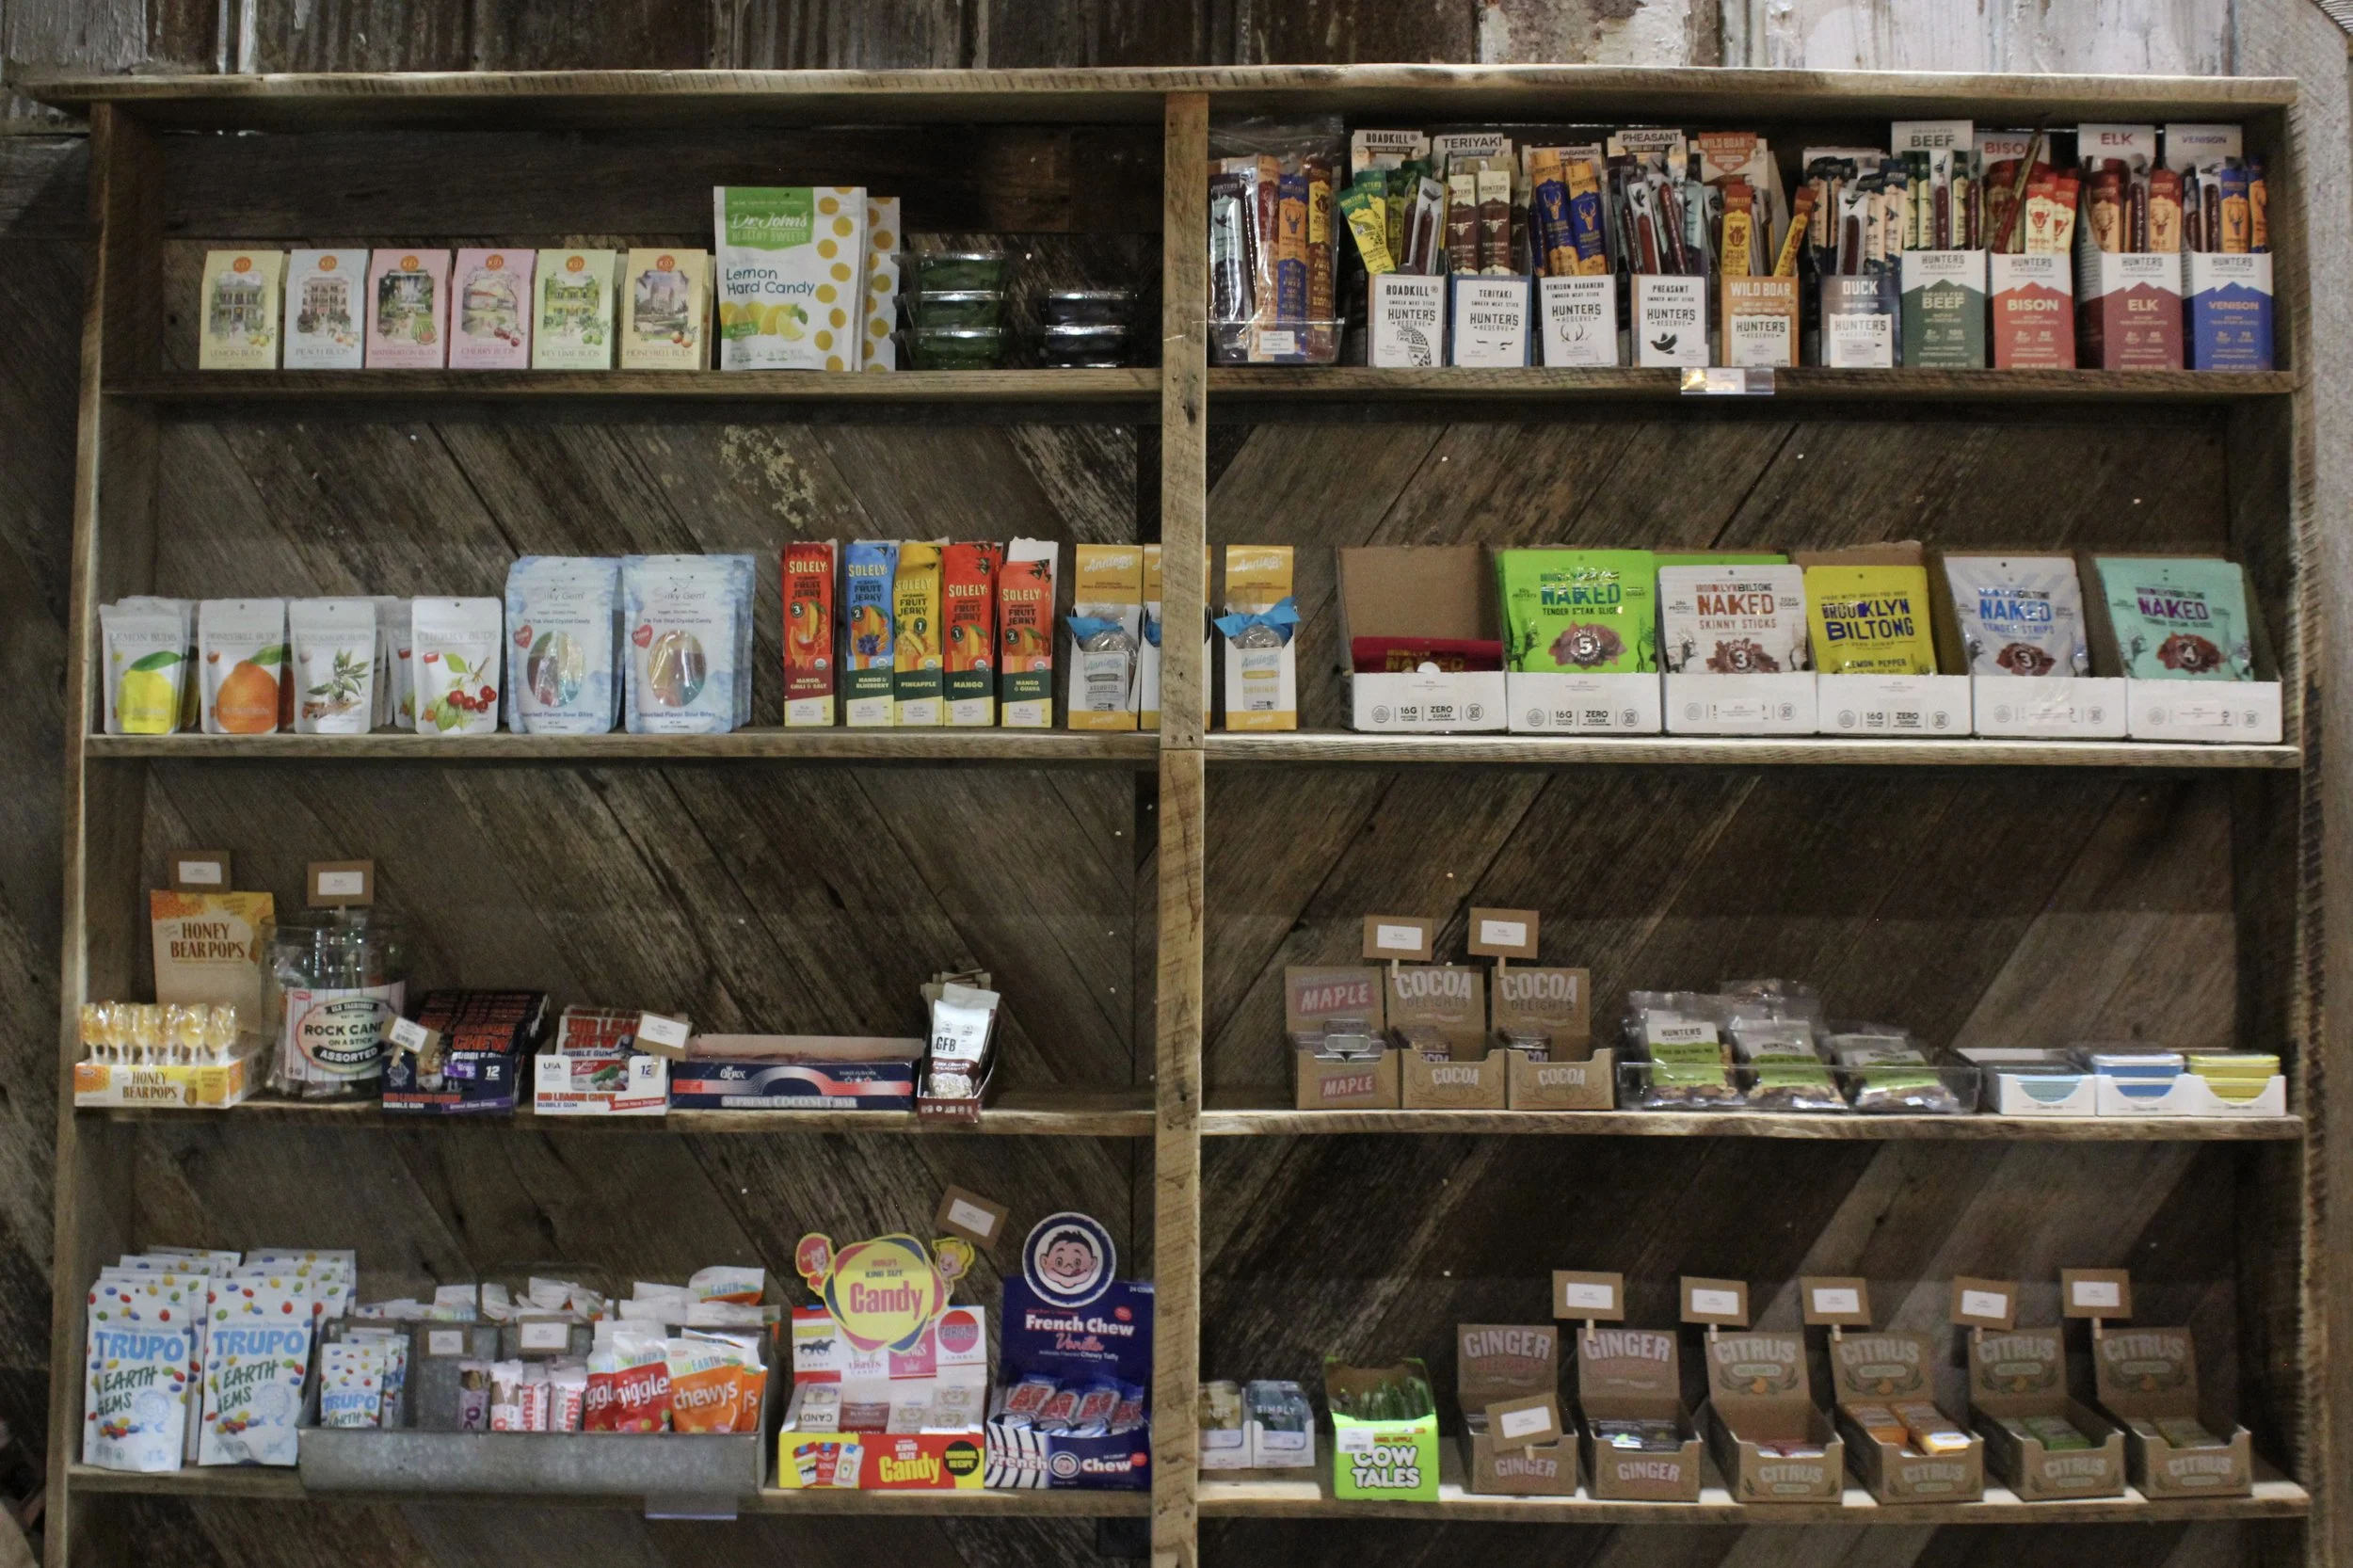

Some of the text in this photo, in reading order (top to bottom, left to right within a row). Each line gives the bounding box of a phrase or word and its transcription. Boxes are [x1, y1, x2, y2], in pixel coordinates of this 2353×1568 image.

[1366, 133, 1408, 144] ROADKILL
[1442, 136, 1503, 149] TERIYAKI
[1622, 133, 1679, 142] PHEASANT
[1911, 135, 1954, 148] BEEF
[2101, 133, 2134, 145] ELK
[726, 267, 777, 281] Lemon
[727, 281, 815, 297] Hard Candy
[1385, 284, 1430, 297] ROADKILL
[1479, 289, 1513, 299] TERIYAKI
[1652, 284, 1689, 294] PHEASANT
[1731, 282, 1792, 296] WILD BOAR
[1842, 280, 1879, 296] DUCK
[1552, 302, 1602, 317] HUNTER'S
[1922, 296, 1965, 310] BEEF
[2007, 298, 2059, 312] BISON
[2127, 298, 2159, 312] ELK
[2208, 300, 2259, 311] VENISON
[1387, 308, 1436, 322] HUNTER'S
[1469, 312, 1519, 327] HUNTER'S
[1647, 308, 1696, 321] HUNTER'S
[1736, 321, 1785, 333] HUNTER'S
[789, 560, 827, 574] SOLELY
[848, 564, 887, 578] SOLELY
[794, 580, 821, 590] FRUIT
[854, 584, 882, 594] FRUIT
[894, 577, 933, 592] SOLELY
[948, 584, 987, 598] SOLELY
[792, 589, 822, 600] JERKY
[853, 592, 882, 603] JERKY
[1002, 588, 1041, 602] SOLELY
[1541, 582, 1622, 605] NAKED
[899, 598, 927, 607] FRUIT
[954, 604, 981, 613] FRUIT
[1697, 594, 1775, 616] NAKED
[2137, 597, 2210, 620] NAKED
[793, 605, 801, 615] 3
[854, 609, 861, 618] 2
[897, 606, 929, 617] JERKY
[1008, 608, 1035, 616] FRUIT
[1543, 607, 1569, 616] TENDER
[1979, 599, 2052, 622] NAKED
[952, 612, 982, 623] JERKY
[1006, 616, 1037, 627] JERKY
[1699, 618, 1777, 630] SKINNY STICKS
[1826, 616, 1915, 641] BILTONG
[150, 632, 177, 642] BUDS
[417, 631, 497, 642] CHERRY BUDS
[1008, 632, 1016, 641] 2
[1578, 637, 1593, 655] 5
[1735, 650, 1748, 668] 3
[1847, 658, 1907, 668] LEMON PEPPER
[953, 680, 984, 689] MANGO
[1400, 706, 1417, 715] 16G
[1430, 705, 1453, 713] ZERO
[1555, 710, 1573, 719] 16G
[1585, 710, 1609, 718] ZERO
[1866, 712, 1884, 721] 16G
[1896, 712, 1920, 721] ZERO
[182, 921, 231, 939] HONEY
[170, 941, 245, 958] BEAR POPS
[1393, 969, 1473, 1000] COCOA
[1500, 971, 1578, 1004] COCOA
[1301, 983, 1369, 1012] MAPLE
[1405, 997, 1469, 1009] DELIGHTS
[1511, 1000, 1575, 1012] DELIGHTS
[304, 1024, 345, 1035] ROCK
[349, 1037, 374, 1046] STICK
[453, 1034, 510, 1051] CHEW
[936, 1035, 956, 1052] GFB
[320, 1047, 377, 1063] ASSORTED
[133, 1071, 168, 1085] HONEY
[485, 1064, 501, 1078] 12
[1431, 1067, 1480, 1085] COCOA
[1537, 1068, 1587, 1086] COCOA
[122, 1085, 178, 1099] BEAR POPS
[1323, 1076, 1373, 1097] MAPLE
[721, 1095, 857, 1108] SUPREME COCONUT BAR
[865, 1270, 904, 1279] KING SIZE
[849, 1281, 923, 1320] Candy
[1025, 1314, 1135, 1337] French Chew
[94, 1331, 184, 1362] TRUPO
[213, 1329, 305, 1356] TRUPO
[1464, 1330, 1552, 1361] GINGER
[1583, 1332, 1672, 1363] GINGER
[2102, 1335, 2186, 1363] CITRUS
[1712, 1337, 1797, 1365] CITRUS
[1838, 1337, 1920, 1365] CITRUS
[1977, 1336, 2057, 1364] CITRUS
[104, 1365, 158, 1393] EARTH
[223, 1359, 280, 1390] EARTH
[673, 1380, 739, 1410] chewys
[323, 1393, 377, 1413] TRUPO
[1257, 1404, 1296, 1416] SIMPLY
[895, 1443, 918, 1452] KING
[944, 1449, 978, 1460] ORIGINAL
[897, 1451, 917, 1461] SIZE
[988, 1449, 1132, 1473] French Chew
[1352, 1446, 1418, 1468] COW
[879, 1452, 941, 1484] Candy
[949, 1459, 976, 1469] RECIPE
[1495, 1459, 1558, 1478] GINGER
[2043, 1458, 2107, 1479] CITRUS
[2167, 1456, 2233, 1476] CITRUS
[1351, 1466, 1421, 1489] TALES
[1617, 1462, 1680, 1482] GINGER
[1758, 1464, 1824, 1484] CITRUS
[1901, 1463, 1966, 1483] CITRUS
